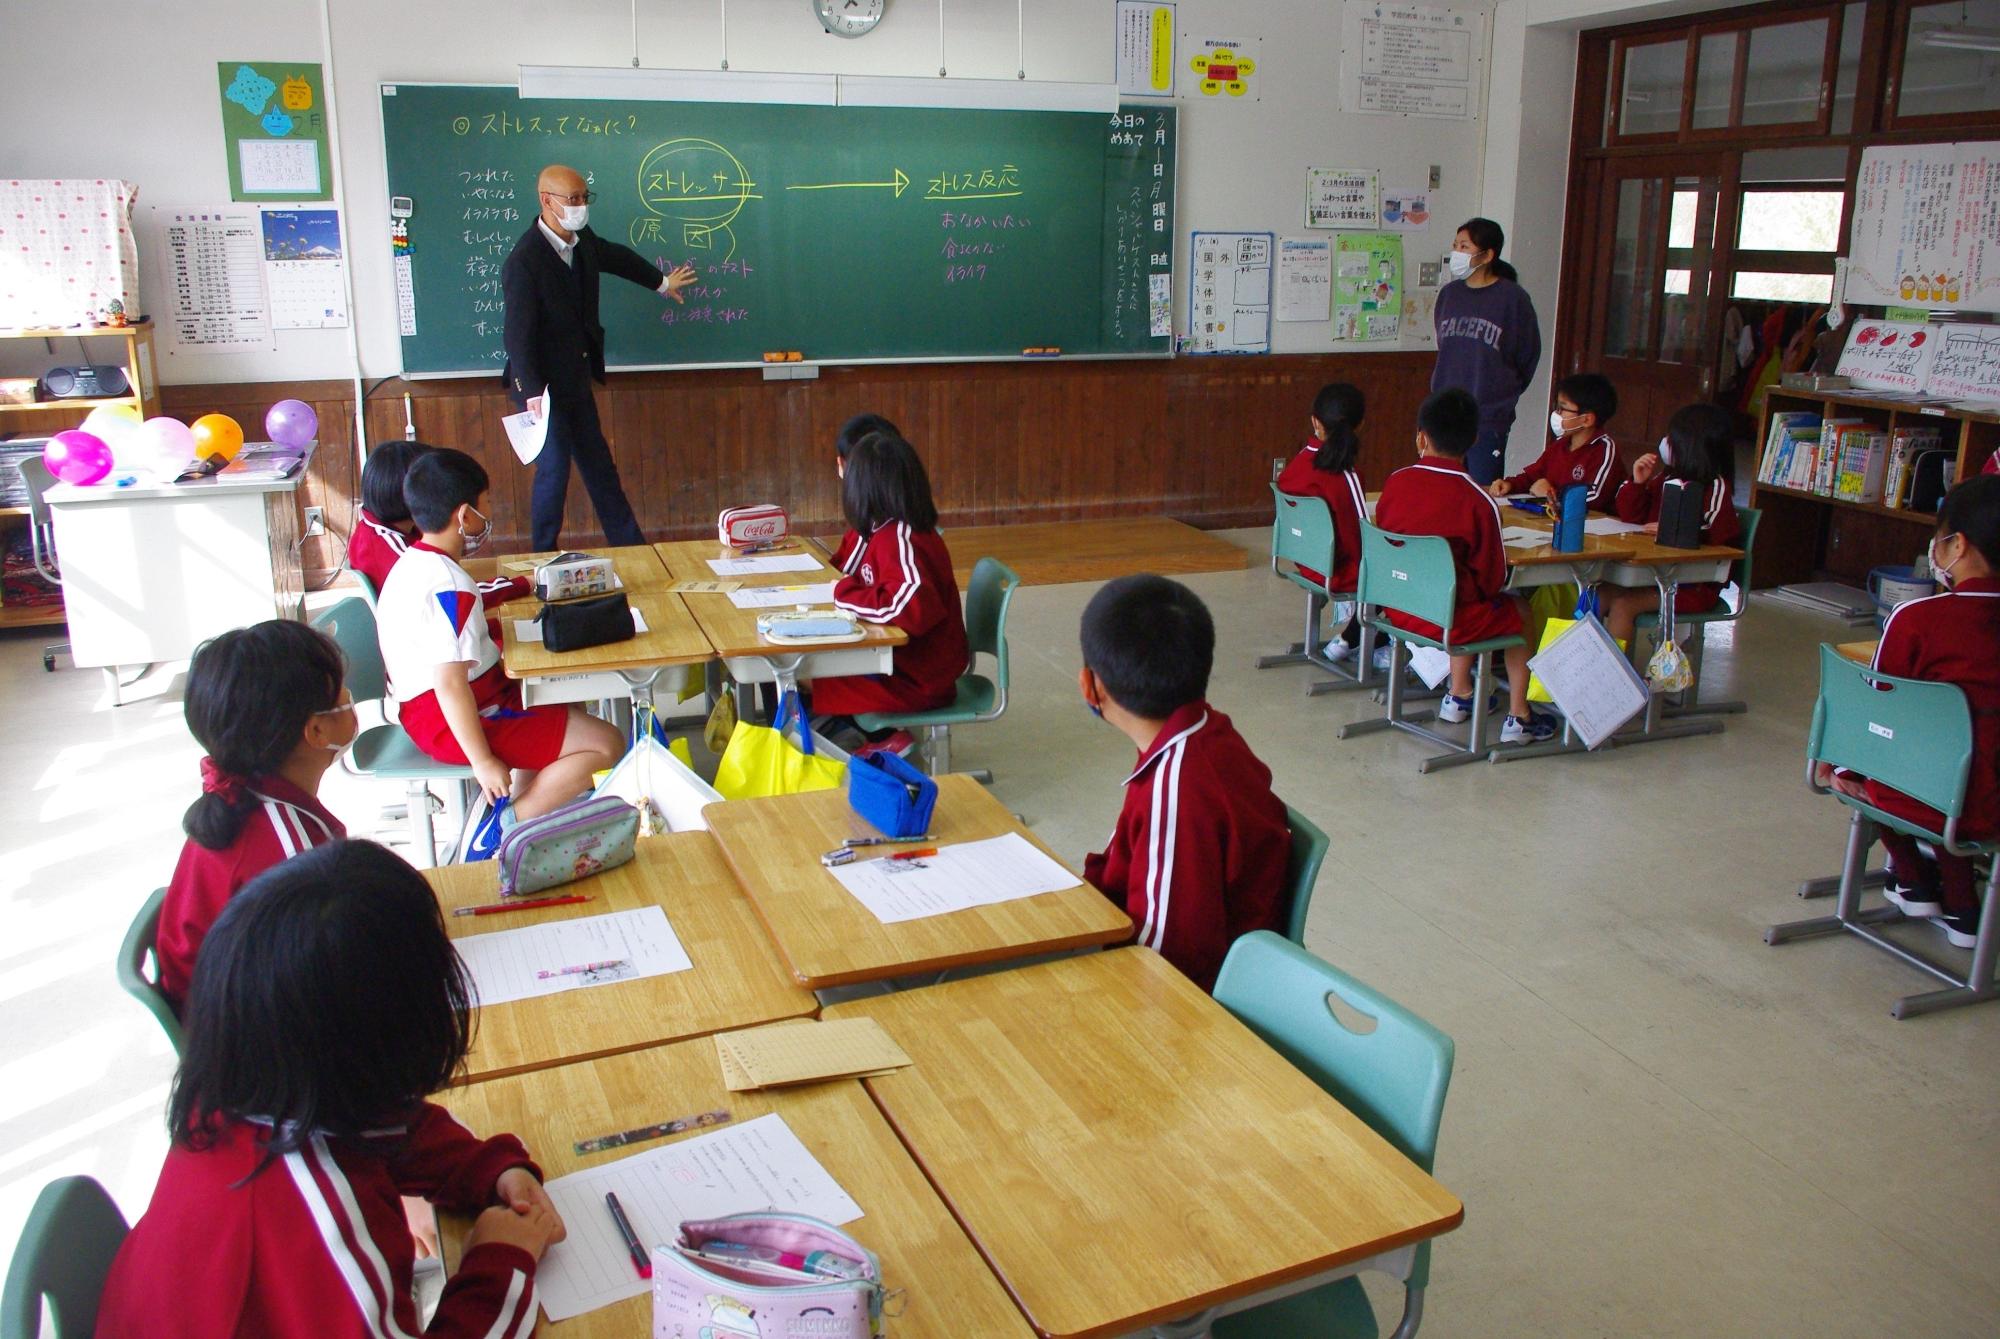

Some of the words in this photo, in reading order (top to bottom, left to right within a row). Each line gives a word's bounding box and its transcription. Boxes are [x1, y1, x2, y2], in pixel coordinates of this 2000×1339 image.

[1109, 113, 1145, 129] 今日の
[1110, 132, 1144, 147] めあて
[458, 168, 515, 184] つかれた
[647, 168, 757, 194] ストレッサー
[927, 164, 1021, 195] ストレス反応
[462, 188, 515, 202] いやになる
[463, 207, 520, 223] イライラする
[941, 211, 1032, 229] おなかいたい
[1150, 252, 1169, 266] 日直
[1203, 252, 1214, 263] 国
[1219, 252, 1230, 264] 外
[945, 263, 987, 283] イライラ
[1204, 269, 1214, 282] 学
[1203, 287, 1214, 300] 体
[1204, 304, 1214, 316] 音
[1204, 322, 1214, 334] 書
[1204, 338, 1215, 350] 社
